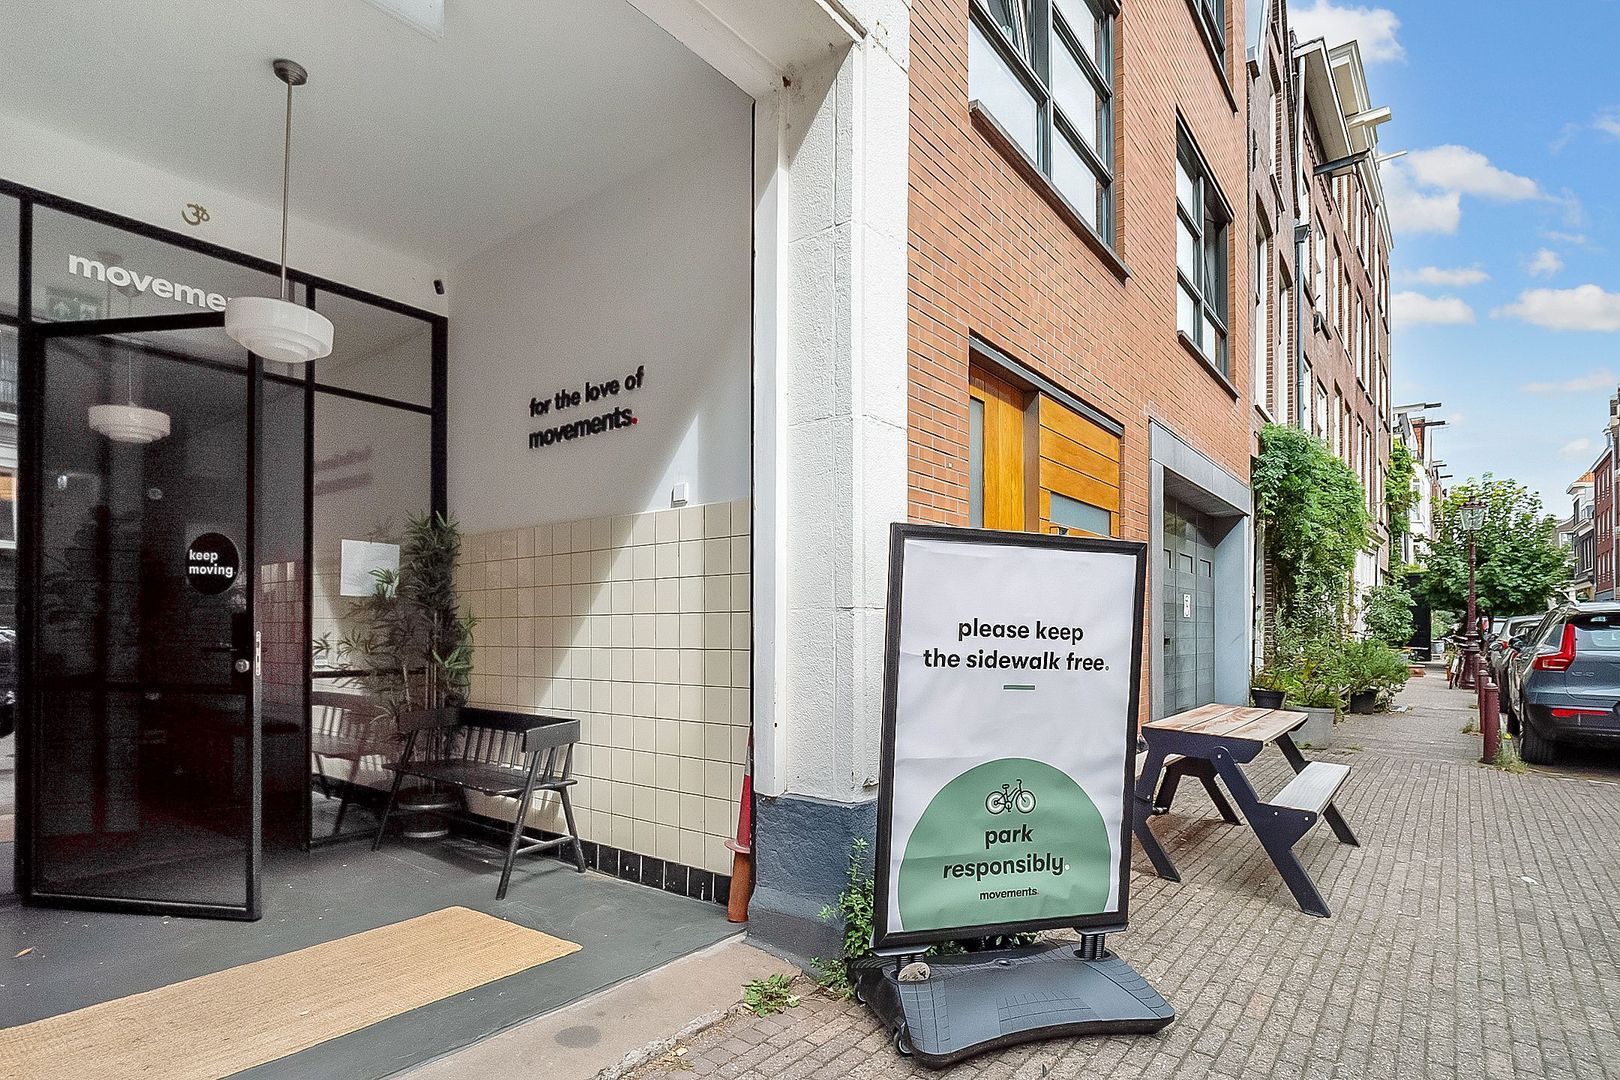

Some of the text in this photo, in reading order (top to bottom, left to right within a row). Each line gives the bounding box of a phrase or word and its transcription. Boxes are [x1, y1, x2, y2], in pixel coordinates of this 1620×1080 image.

[68, 254, 232, 312] moveme
[529, 365, 645, 418] for the love of
[528, 406, 639, 449] movements.
[188, 549, 219, 564] keep
[958, 618, 1084, 646] please keep
[923, 648, 1110, 671] the sidewalk free.
[985, 824, 1034, 850] park
[943, 853, 1071, 882] responsibly.
